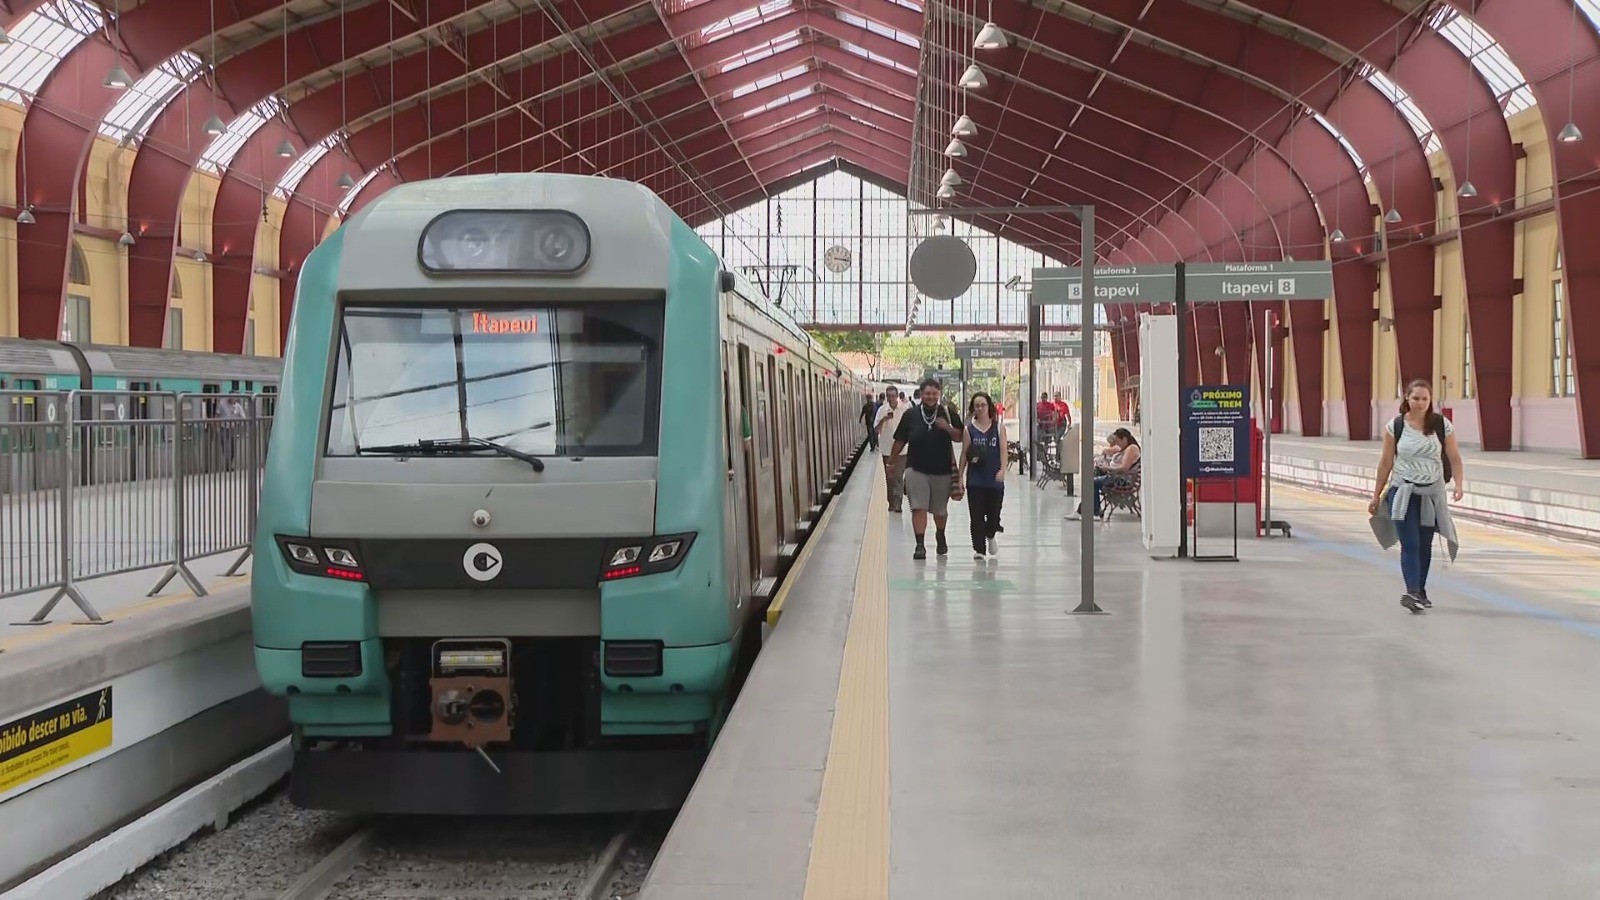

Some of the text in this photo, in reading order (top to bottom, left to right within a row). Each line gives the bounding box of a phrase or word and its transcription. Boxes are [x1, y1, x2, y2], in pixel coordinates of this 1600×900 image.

[1093, 266, 1137, 275] lataforma 2
[1225, 264, 1267, 272] Plataforma
[1073, 282, 1139, 299] 8 tapevi
[1222, 280, 1292, 297] Itapevi 8
[473, 312, 538, 334] Itapevi
[1202, 390, 1242, 399] PRÓXIMO
[29, 718, 57, 742] descer
[60, 713, 70, 729] na
[72, 703, 88, 725] via.
